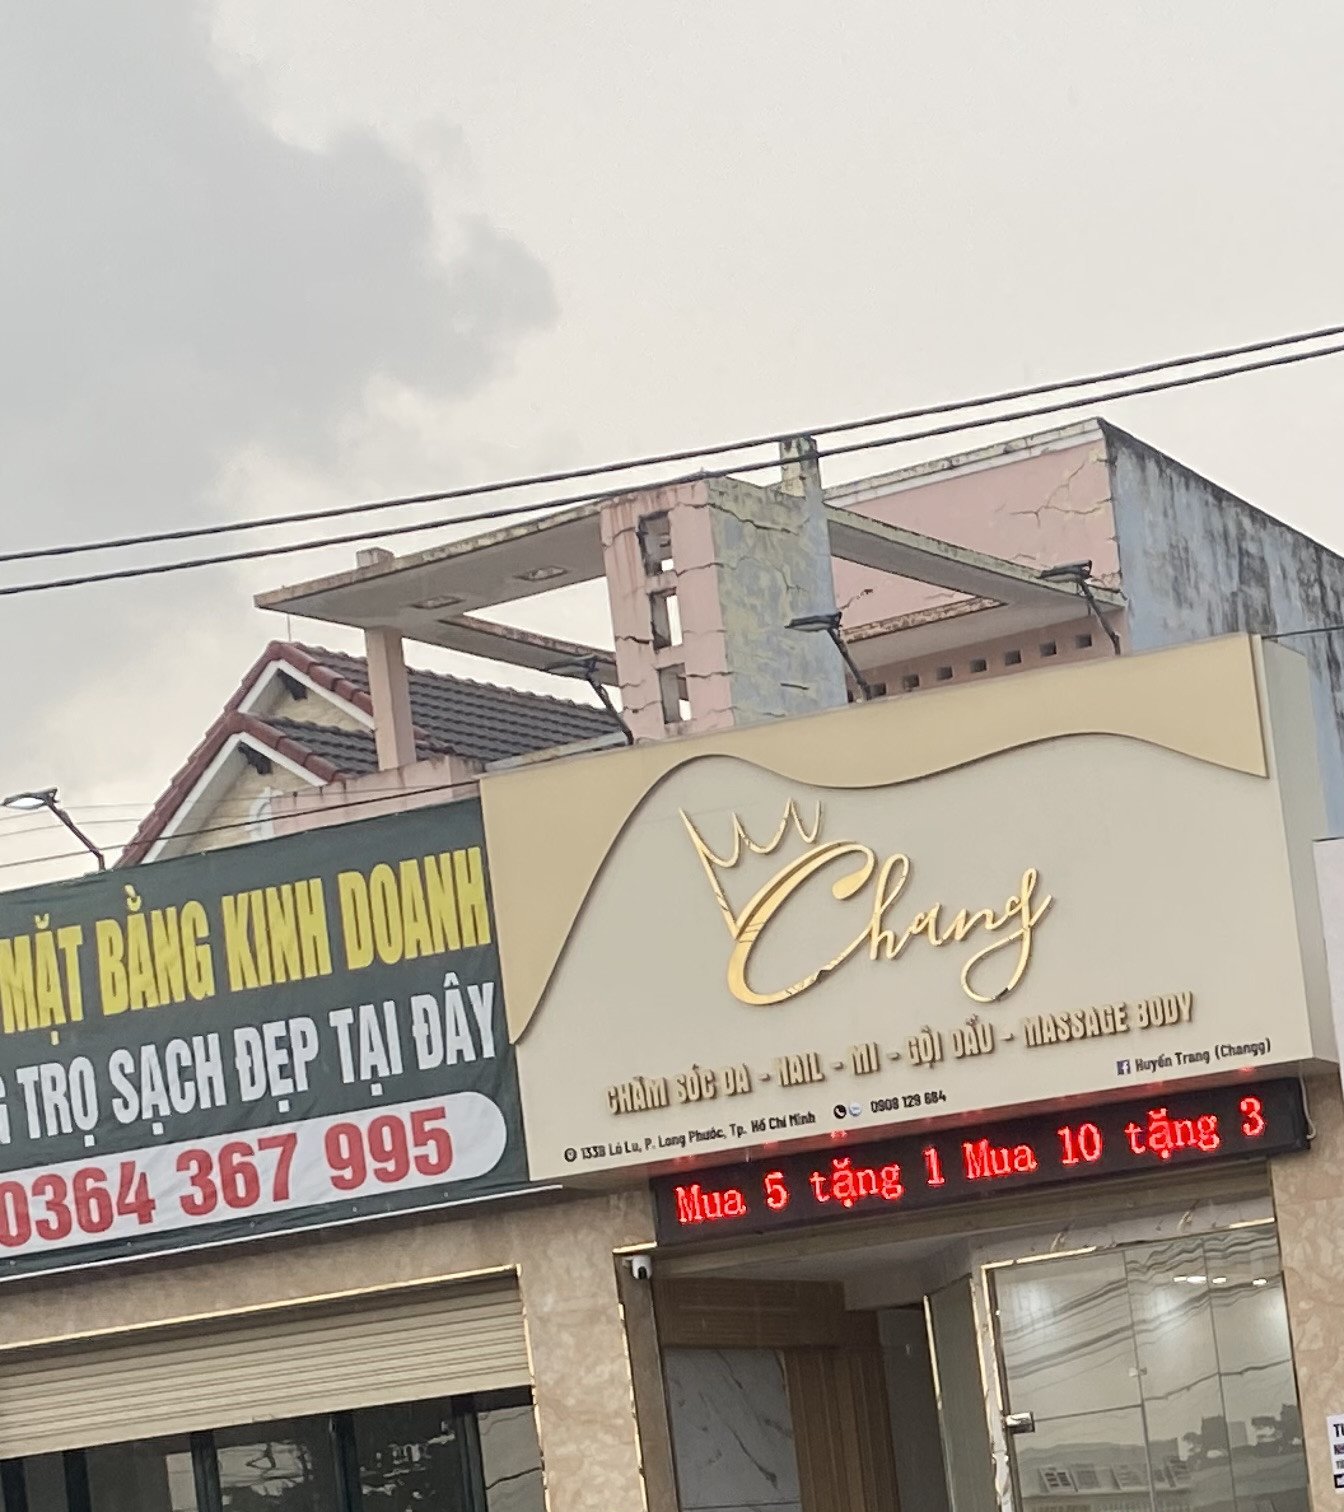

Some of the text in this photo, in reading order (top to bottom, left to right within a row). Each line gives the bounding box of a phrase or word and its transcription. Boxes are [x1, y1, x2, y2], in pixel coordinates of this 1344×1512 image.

[0, 846, 492, 1046] MẶT BẰNG KINH DOANH
[726, 839, 1054, 1005] Chang
[16, 1056, 99, 1147] TRỌ
[111, 1033, 226, 1135] SẠCH
[234, 1017, 319, 1113] ĐẸP
[329, 1000, 404, 1096] TẠI
[410, 972, 496, 1071] ĐÂY
[675, 1063, 717, 1104] SÓC
[771, 1052, 825, 1087] NAIL
[850, 1041, 880, 1076] MI
[1023, 1001, 1130, 1048] MASSAGE
[1136, 990, 1194, 1029] BODY
[1175, 1050, 1210, 1065] Trang
[0, 1107, 454, 1248] 0364 367 995
[675, 1096, 1266, 1225] Mua 5 tặng 1 Mua 10 tặng 3
